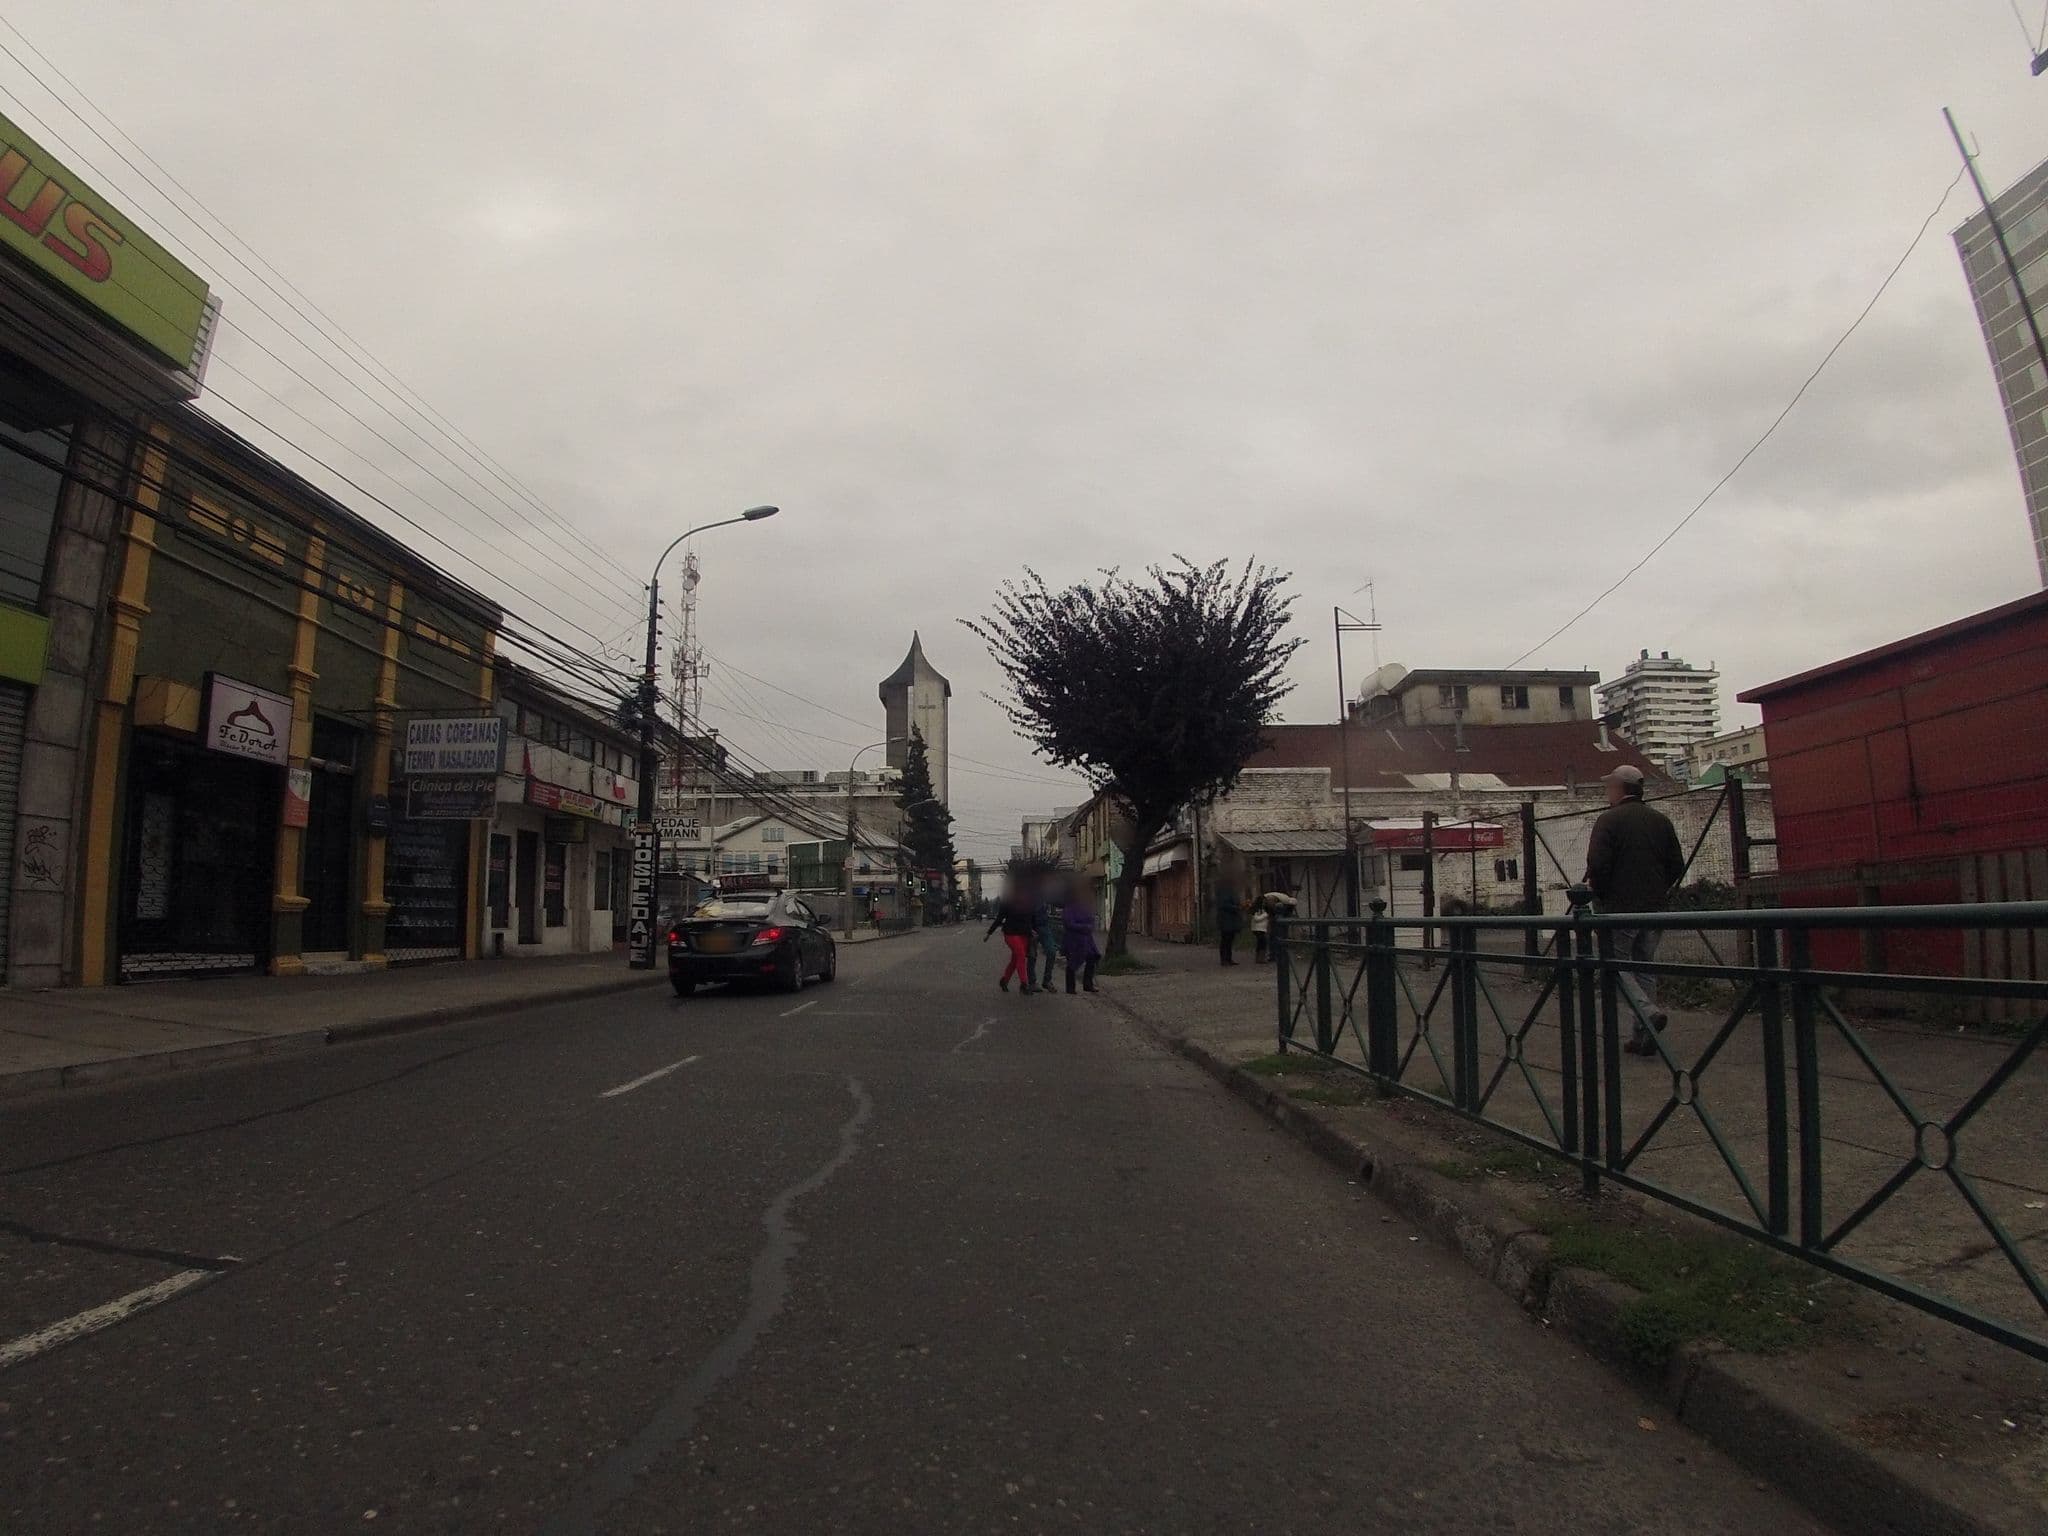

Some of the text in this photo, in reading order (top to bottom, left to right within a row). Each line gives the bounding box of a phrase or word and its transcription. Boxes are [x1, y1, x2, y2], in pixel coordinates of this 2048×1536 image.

[409, 722, 499, 745] CAMAS COREANAS
[439, 749, 496, 769] MASAJEADOR
[454, 779, 474, 792] del
[628, 817, 700, 828] HPEDAJE
[629, 834, 653, 963] HOSPEDAJE
